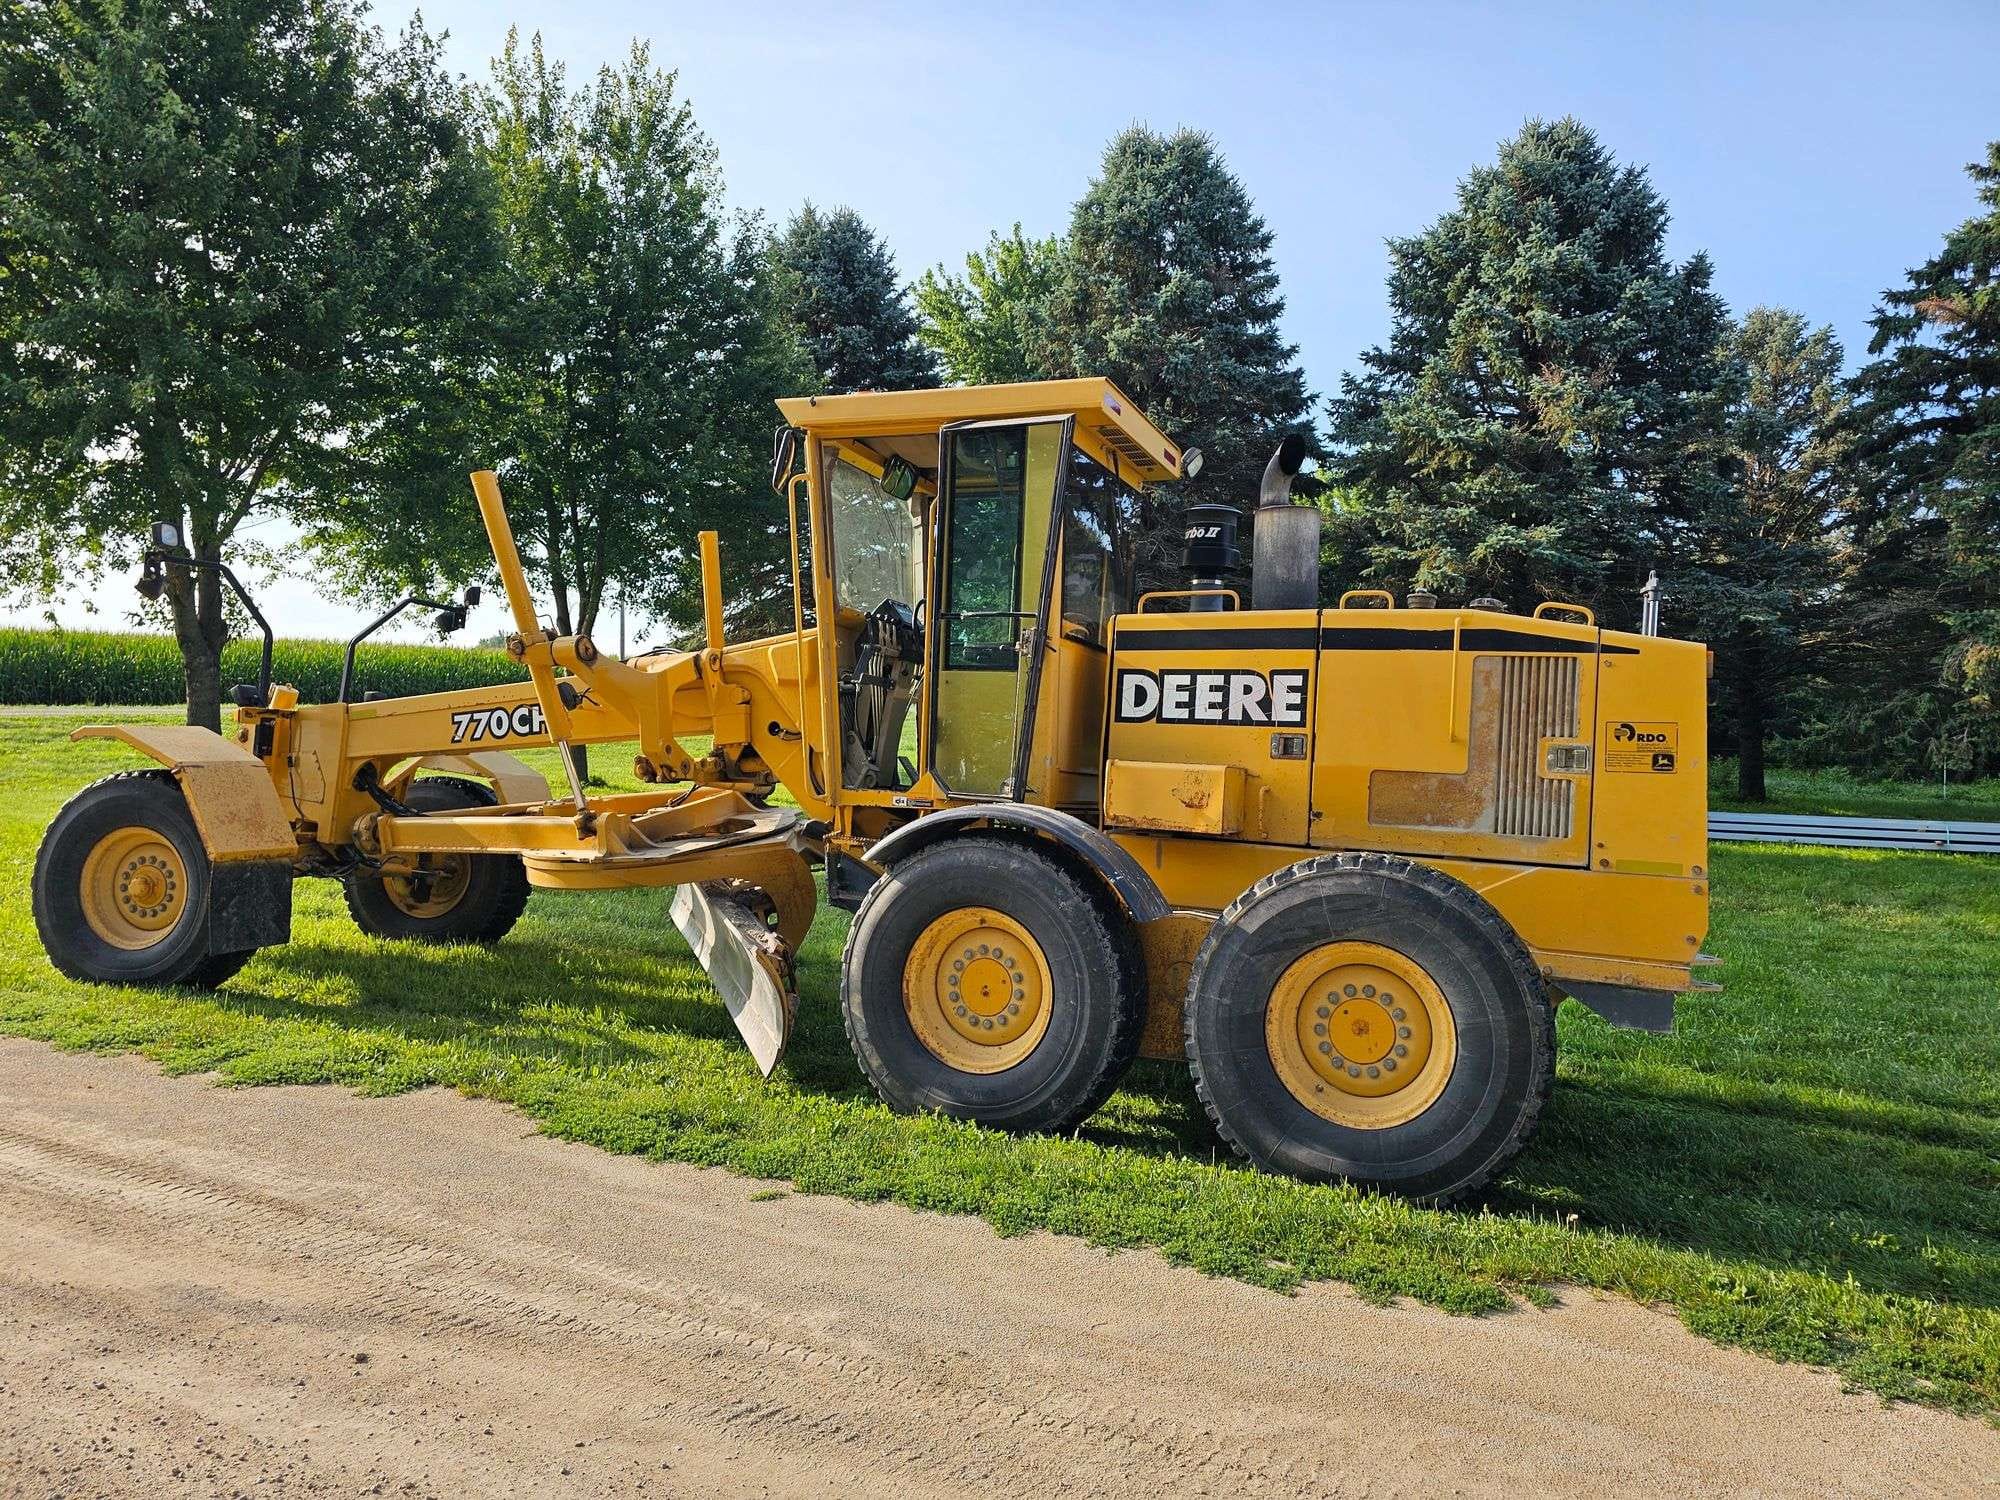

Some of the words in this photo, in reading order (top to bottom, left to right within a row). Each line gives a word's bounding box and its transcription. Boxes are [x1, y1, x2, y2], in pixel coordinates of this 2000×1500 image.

[1121, 674, 1303, 722] DEERE
[453, 705, 547, 741] 770CH
[1636, 733, 1667, 743] RDO
